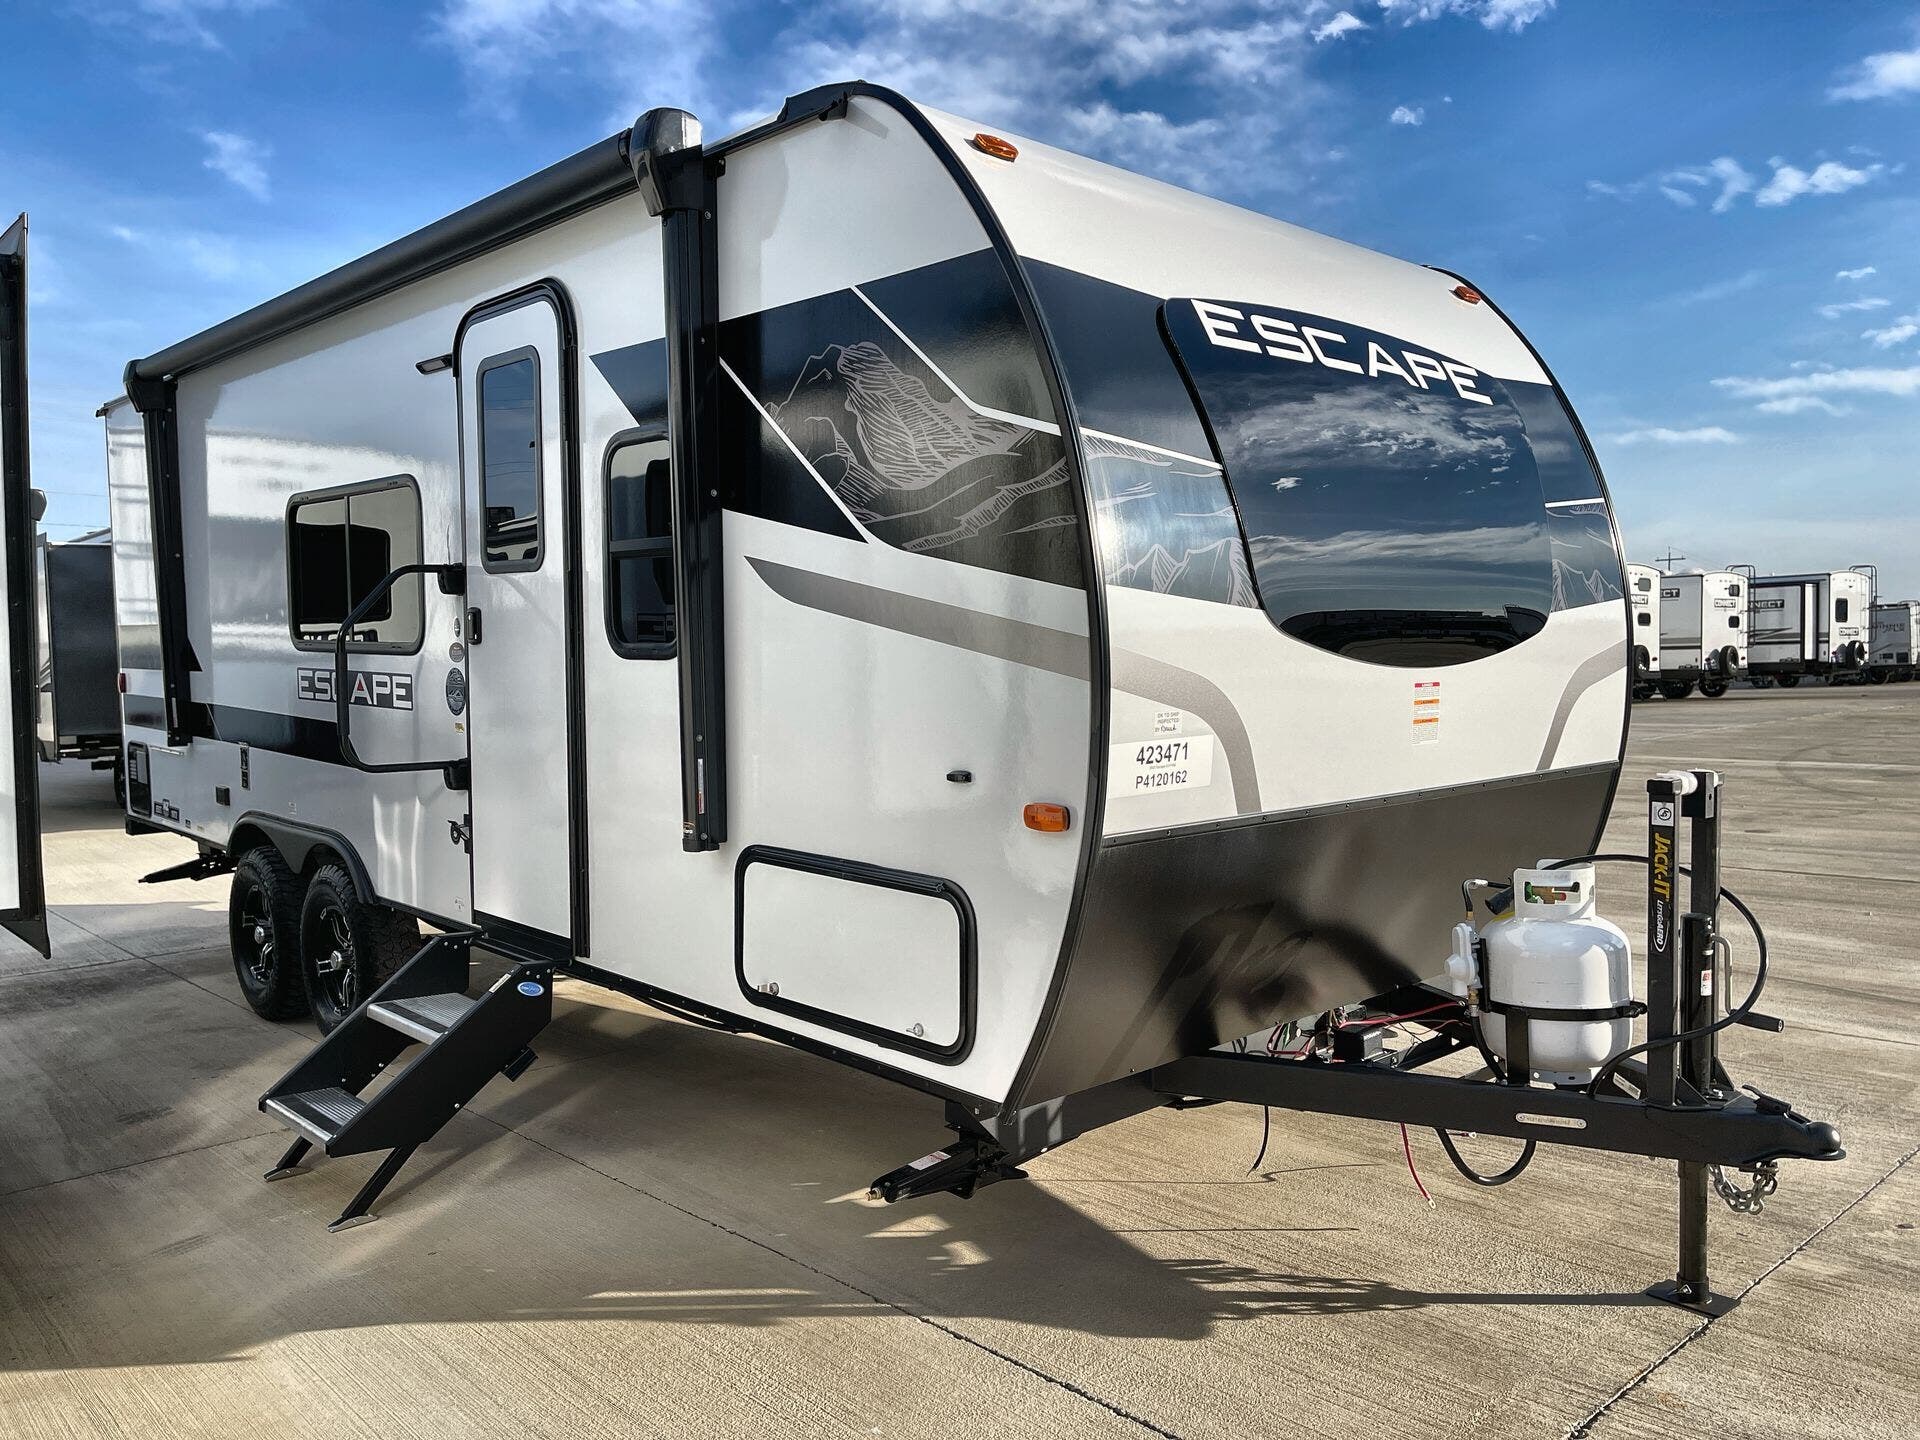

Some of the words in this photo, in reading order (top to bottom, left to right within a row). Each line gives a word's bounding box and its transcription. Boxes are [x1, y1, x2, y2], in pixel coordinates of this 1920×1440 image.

[1191, 299, 1494, 405] ESCAPE
[1136, 742, 1188, 765] 423471
[1135, 770, 1188, 789] P4120162
[1654, 832, 1671, 899] JACK-IT
